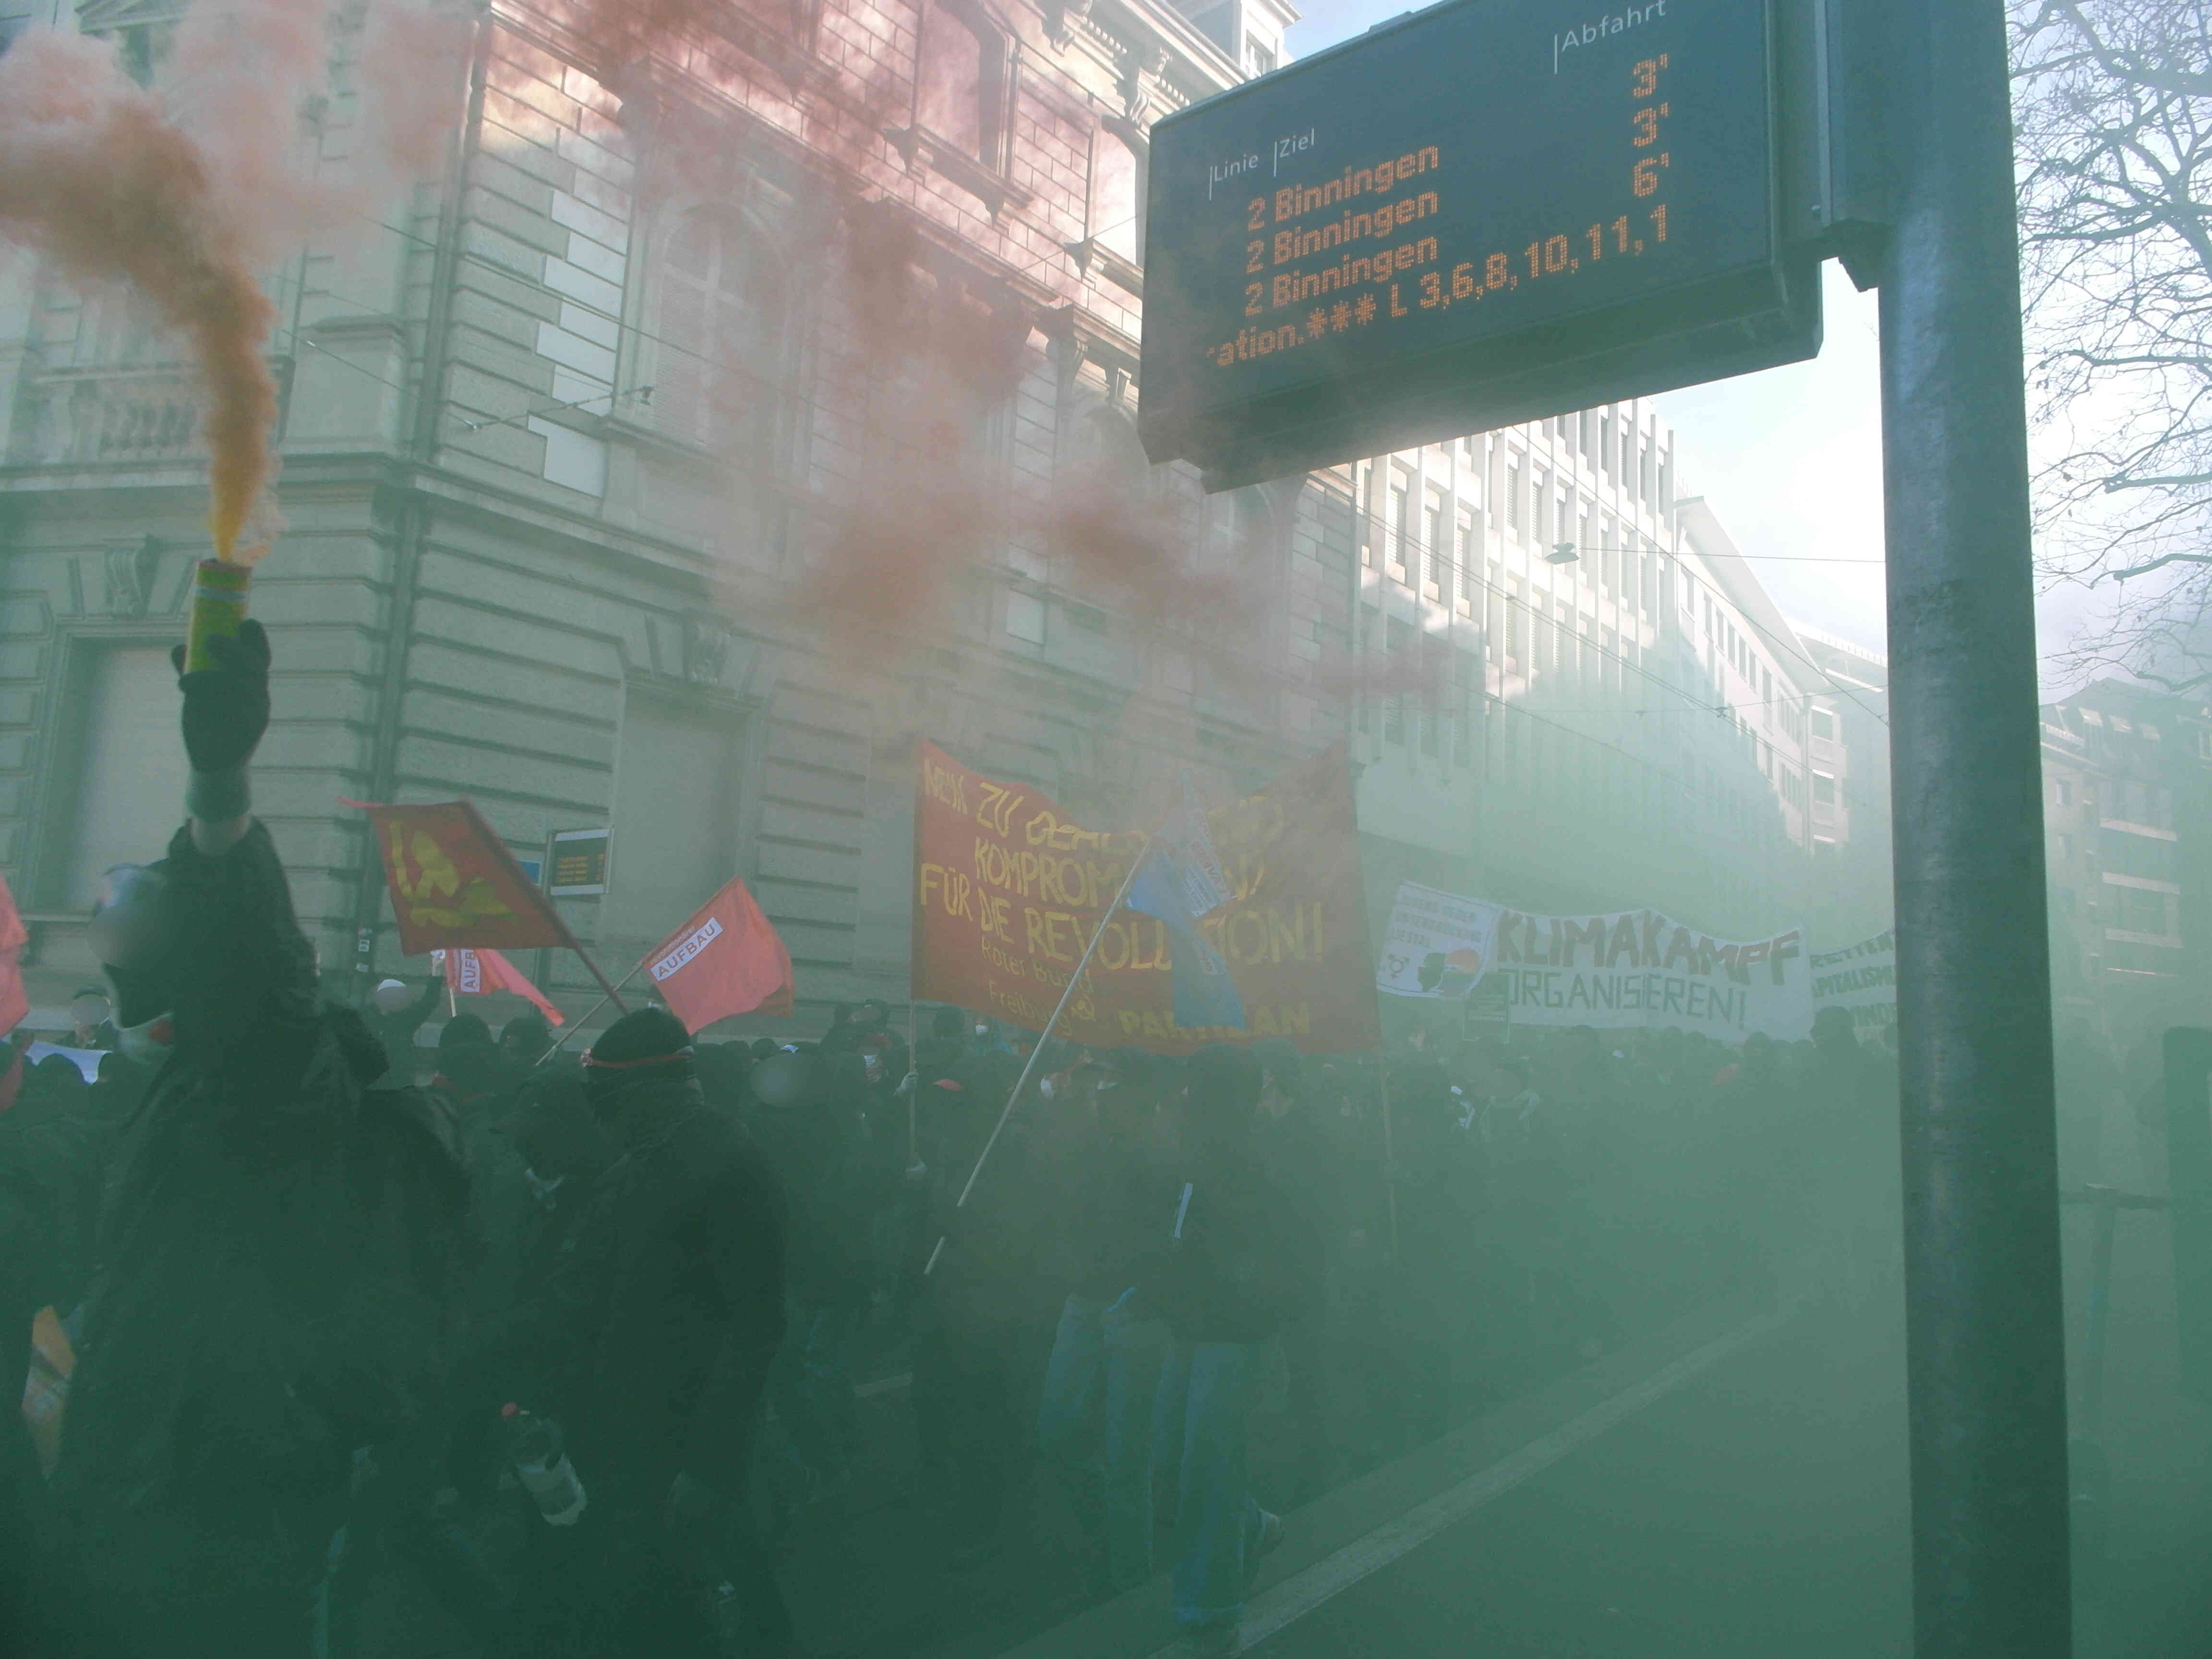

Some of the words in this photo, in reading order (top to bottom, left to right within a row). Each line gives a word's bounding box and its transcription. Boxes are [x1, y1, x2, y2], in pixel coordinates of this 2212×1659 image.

[1214, 153, 1259, 182] Linie
[1279, 127, 1315, 158] Ziel
[1561, 0, 1666, 52] Abfahrt
[1248, 197, 1266, 231] 2
[1275, 145, 1439, 223] Binningen
[1246, 240, 1265, 275] 2
[1273, 191, 1439, 265] Binningen
[1244, 281, 1264, 317] 2
[1272, 236, 1439, 308] Binningen
[1390, 283, 1408, 318] L
[923, 757, 968, 815] NEIN
[975, 781, 1025, 838] ZU
[920, 862, 974, 922] FÜR
[978, 886, 1015, 945] DIE
[658, 923, 715, 978] AUFBAU
[1497, 910, 1800, 986] KLIMAKAMPF
